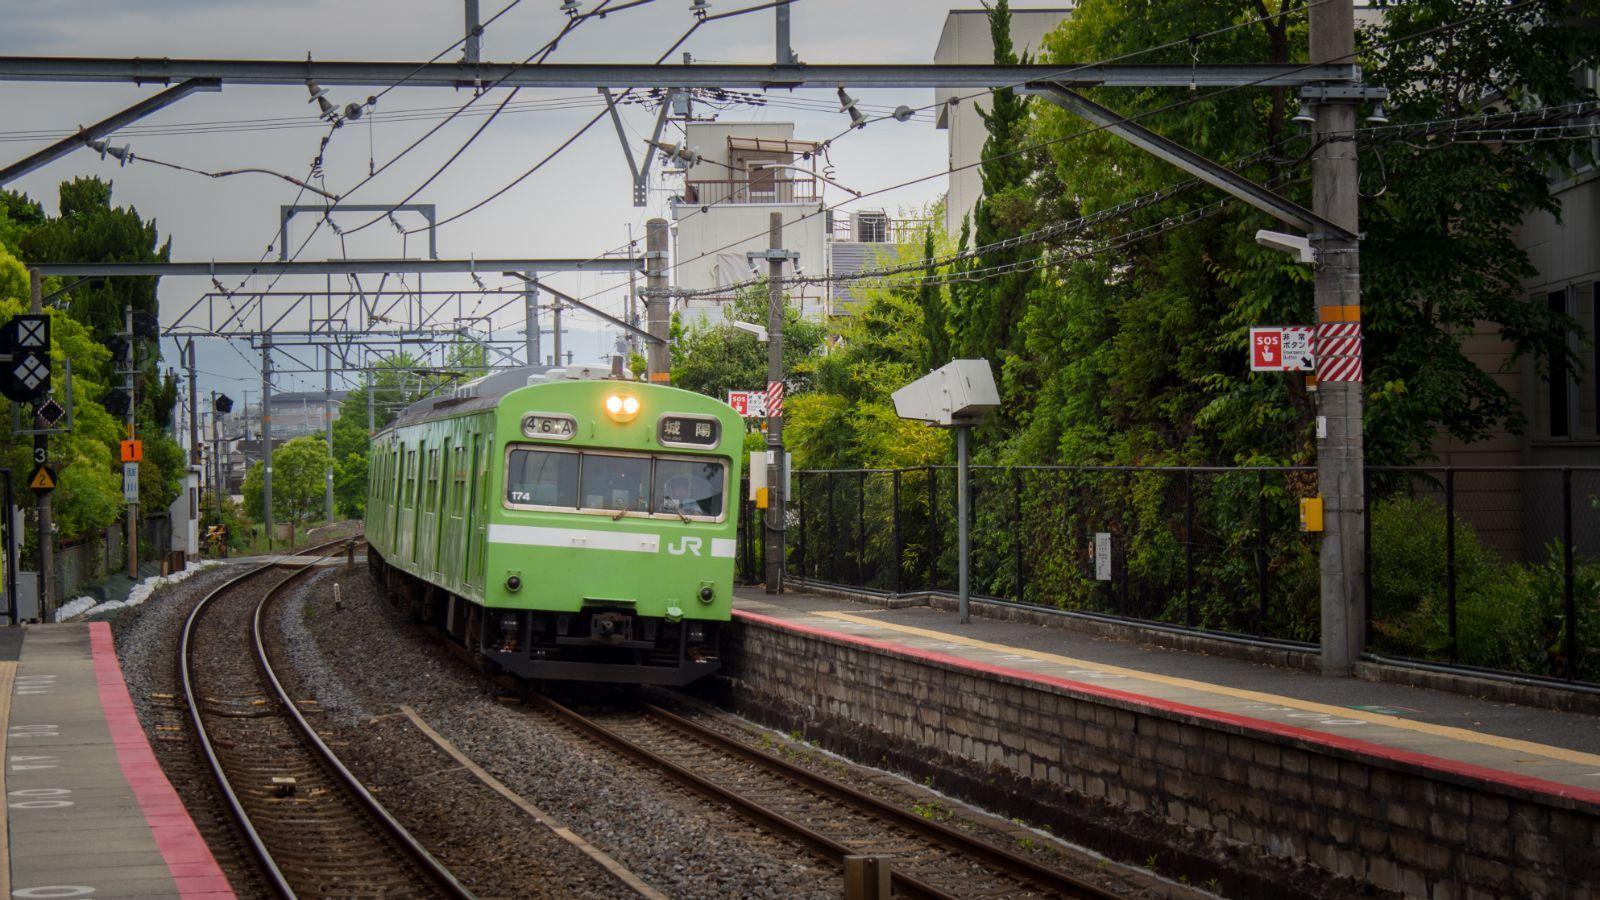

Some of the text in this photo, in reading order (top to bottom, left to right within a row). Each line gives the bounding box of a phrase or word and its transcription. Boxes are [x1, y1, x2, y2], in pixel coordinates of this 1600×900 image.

[1256, 336, 1278, 346] SOS
[34, 447, 46, 463] 3
[128, 443, 135, 458] 1
[39, 474, 46, 486] 2
[511, 491, 530, 501] 174
[667, 536, 703, 557] JR
